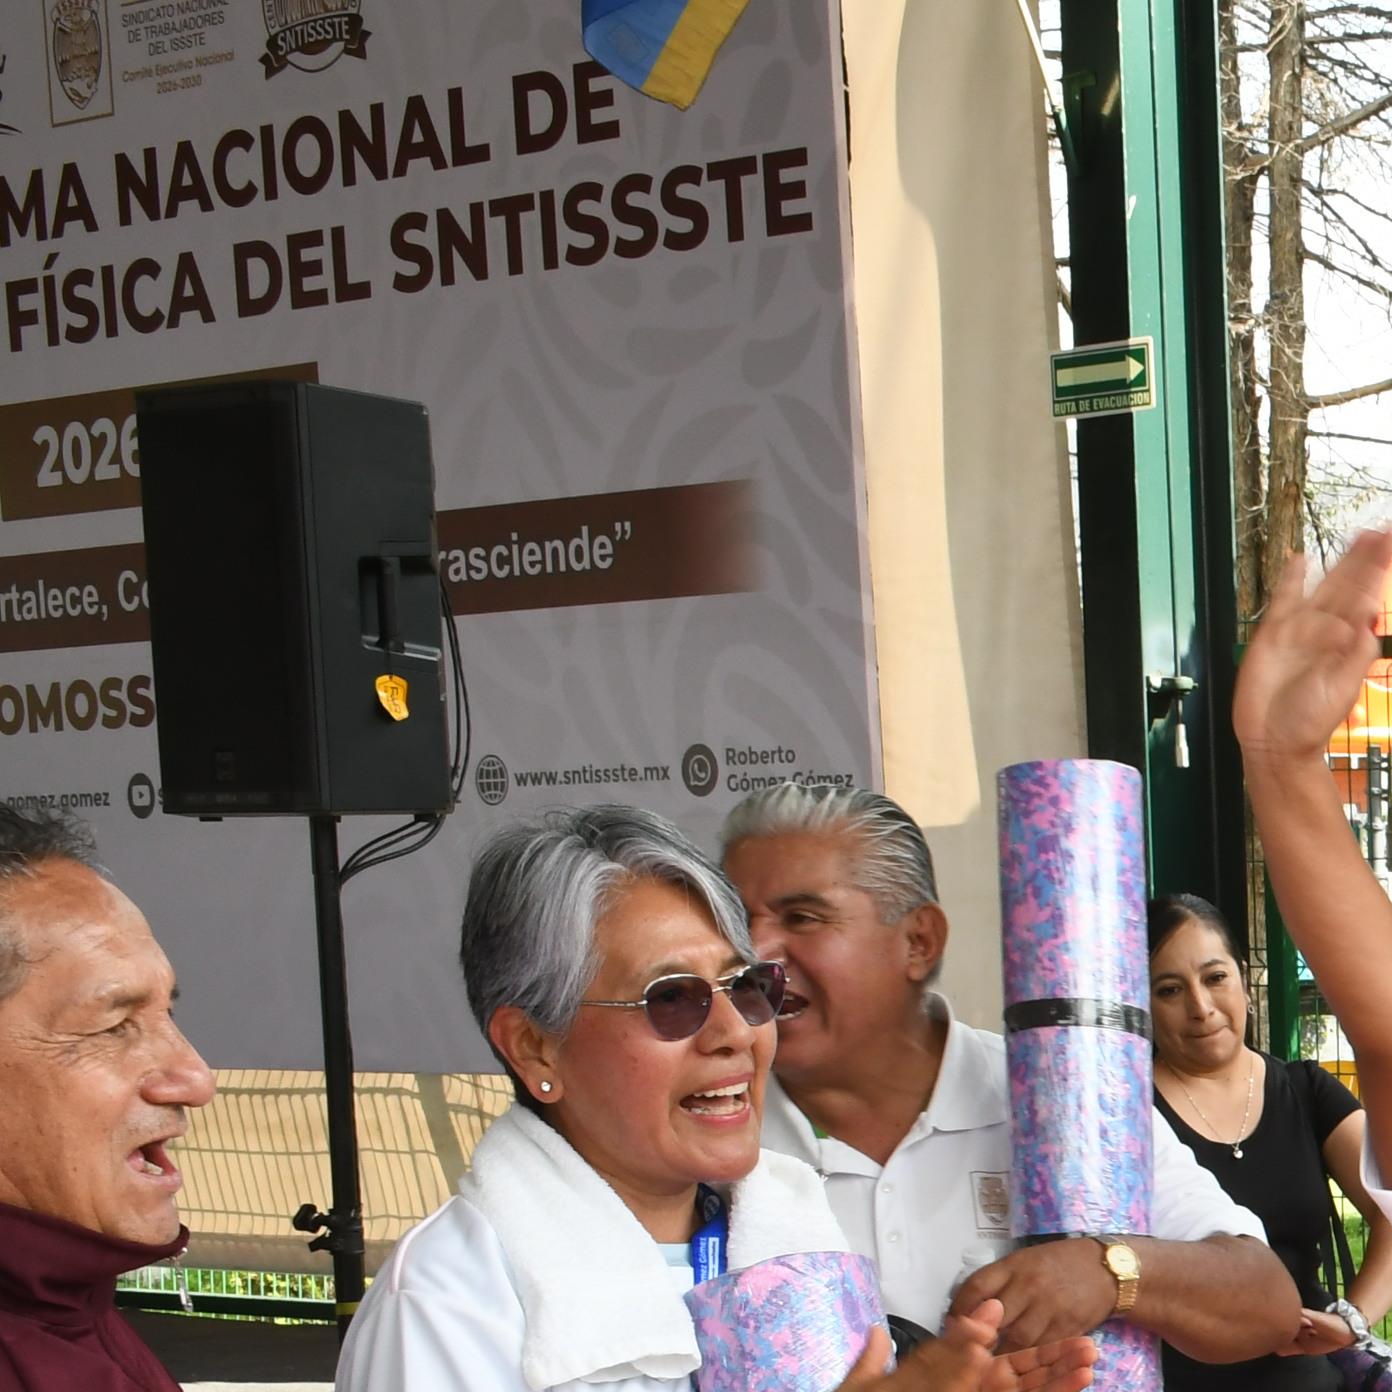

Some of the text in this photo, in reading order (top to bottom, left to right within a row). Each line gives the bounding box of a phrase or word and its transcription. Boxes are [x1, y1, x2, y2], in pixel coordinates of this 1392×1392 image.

[121, 0, 230, 27] SINDICATO NACIONAL
[128, 11, 225, 44] DE TRABAJADORES
[277, 17, 351, 56] SNTISSSTE
[148, 32, 206, 56] DEL ISSSTE
[154, 60, 193, 78] Ejecutivo
[195, 50, 235, 67] Nacional
[115, 86, 491, 227] NACIONAL
[512, 60, 621, 157] DE
[5, 147, 814, 353] FÍSICA DEL SNTISSSTE
[1054, 401, 1079, 415] RUTA
[1079, 399, 1091, 412] DE
[725, 745, 797, 766] Roberto
[514, 763, 671, 787] www.sntissste.mx
